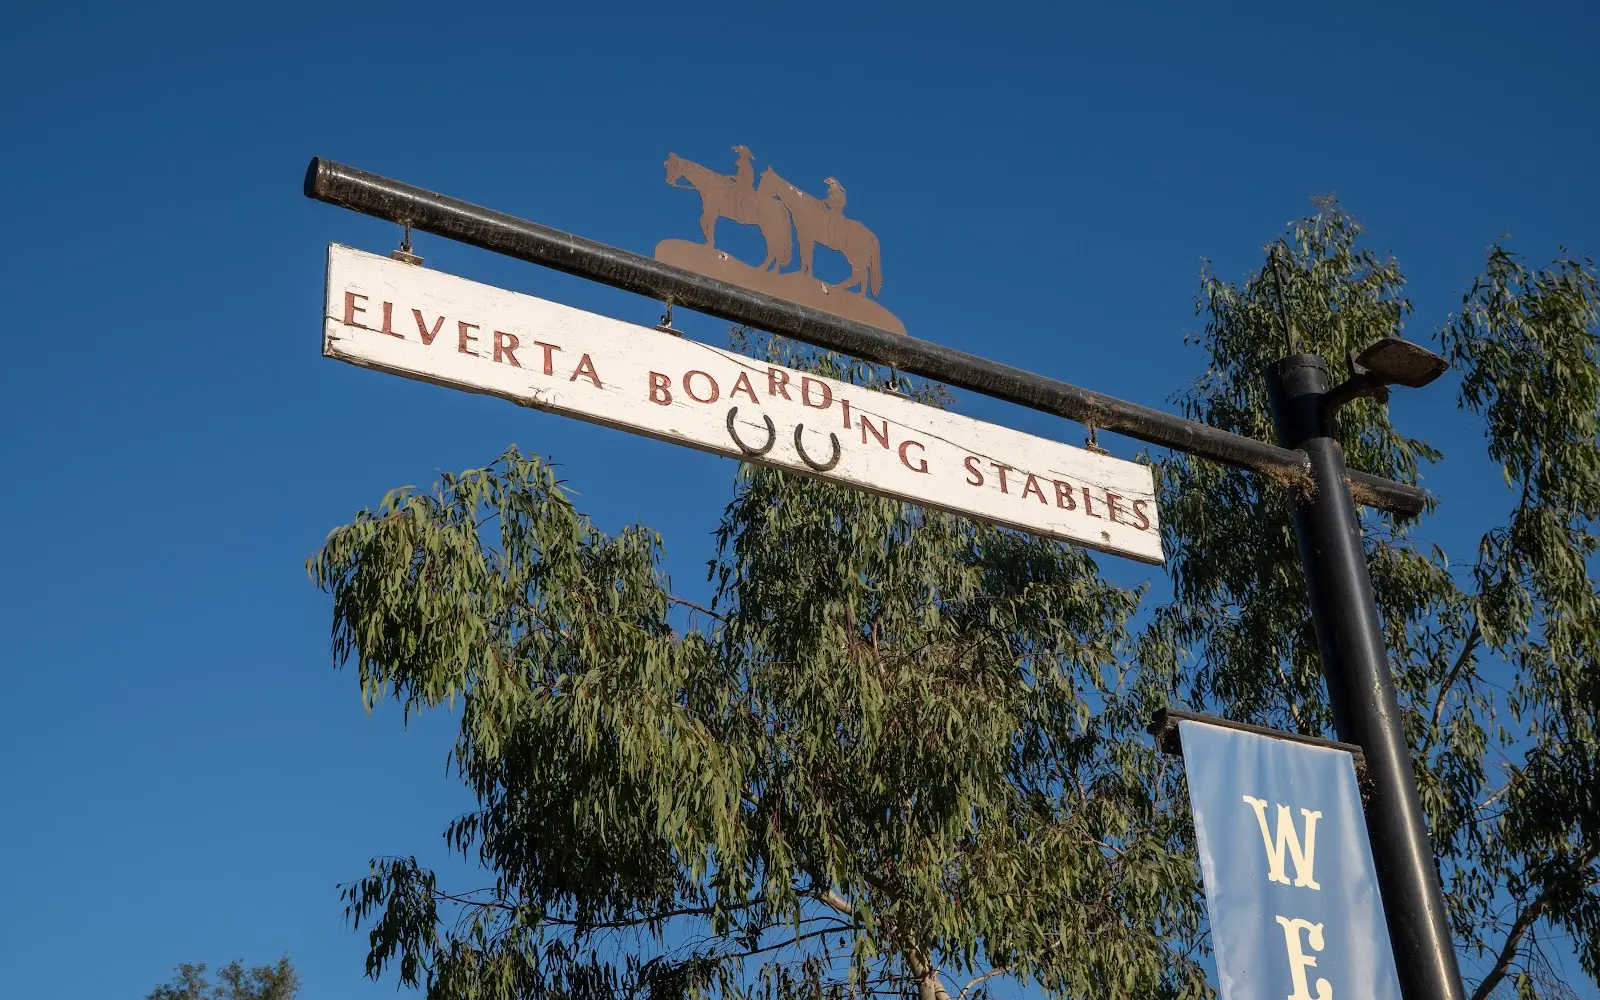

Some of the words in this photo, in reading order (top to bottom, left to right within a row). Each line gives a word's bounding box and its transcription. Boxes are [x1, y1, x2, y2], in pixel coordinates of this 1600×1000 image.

[344, 291, 603, 389] ELVERTA
[648, 366, 930, 474] BOARDING
[963, 456, 1151, 532] STABLES
